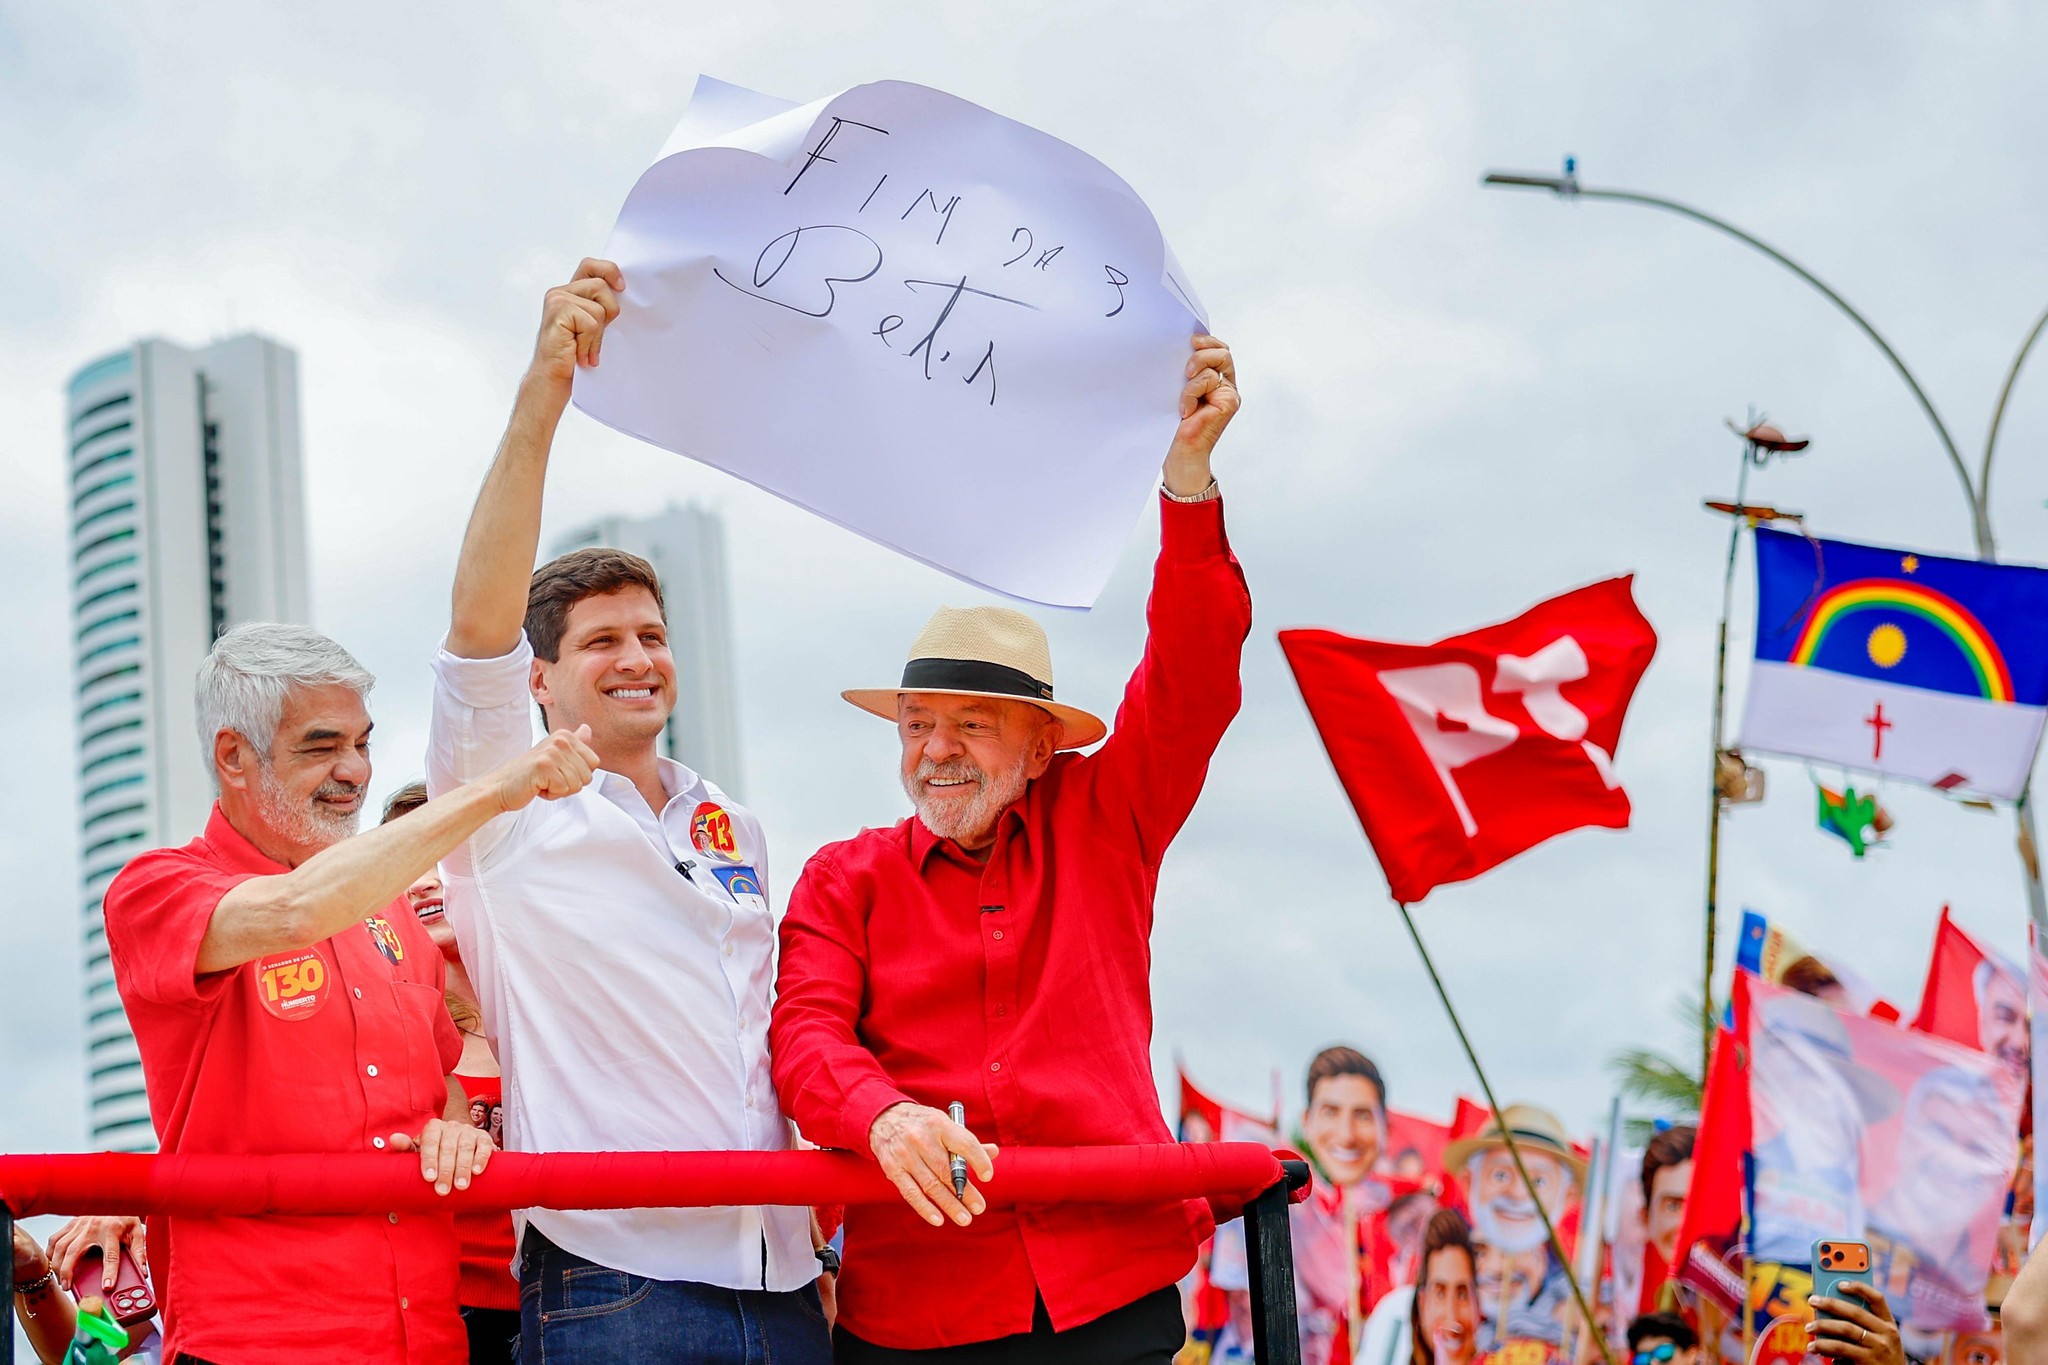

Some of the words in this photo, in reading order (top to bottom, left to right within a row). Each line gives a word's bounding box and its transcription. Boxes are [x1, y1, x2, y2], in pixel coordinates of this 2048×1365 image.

[783, 115, 961, 246] FIM
[706, 813, 735, 854] 13
[376, 923, 399, 952] 13
[261, 958, 324, 1002] 130
